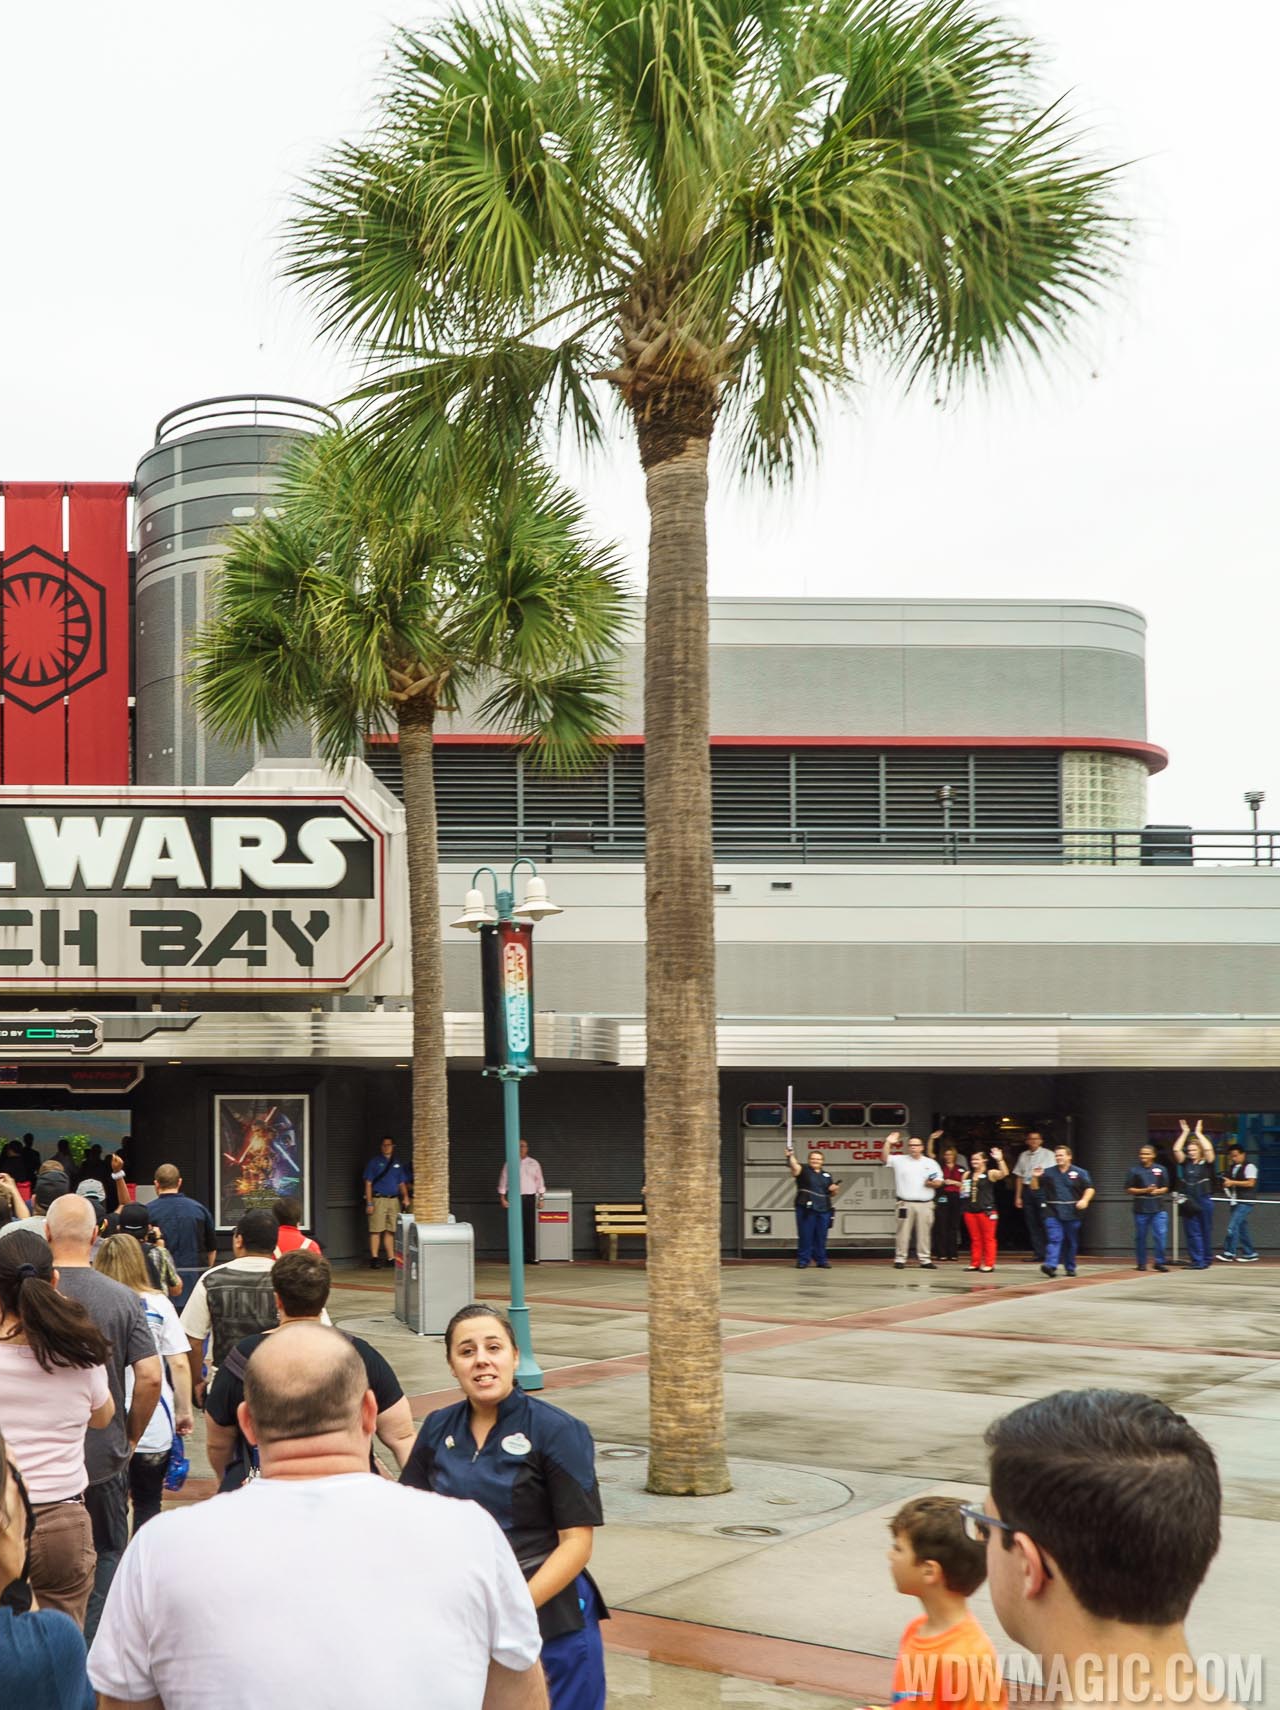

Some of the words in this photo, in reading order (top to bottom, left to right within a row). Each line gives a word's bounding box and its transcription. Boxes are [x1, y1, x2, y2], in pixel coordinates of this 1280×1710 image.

[23, 816, 369, 890] WARS
[129, 909, 331, 967] BAY
[873, 1141, 904, 1149] BY
